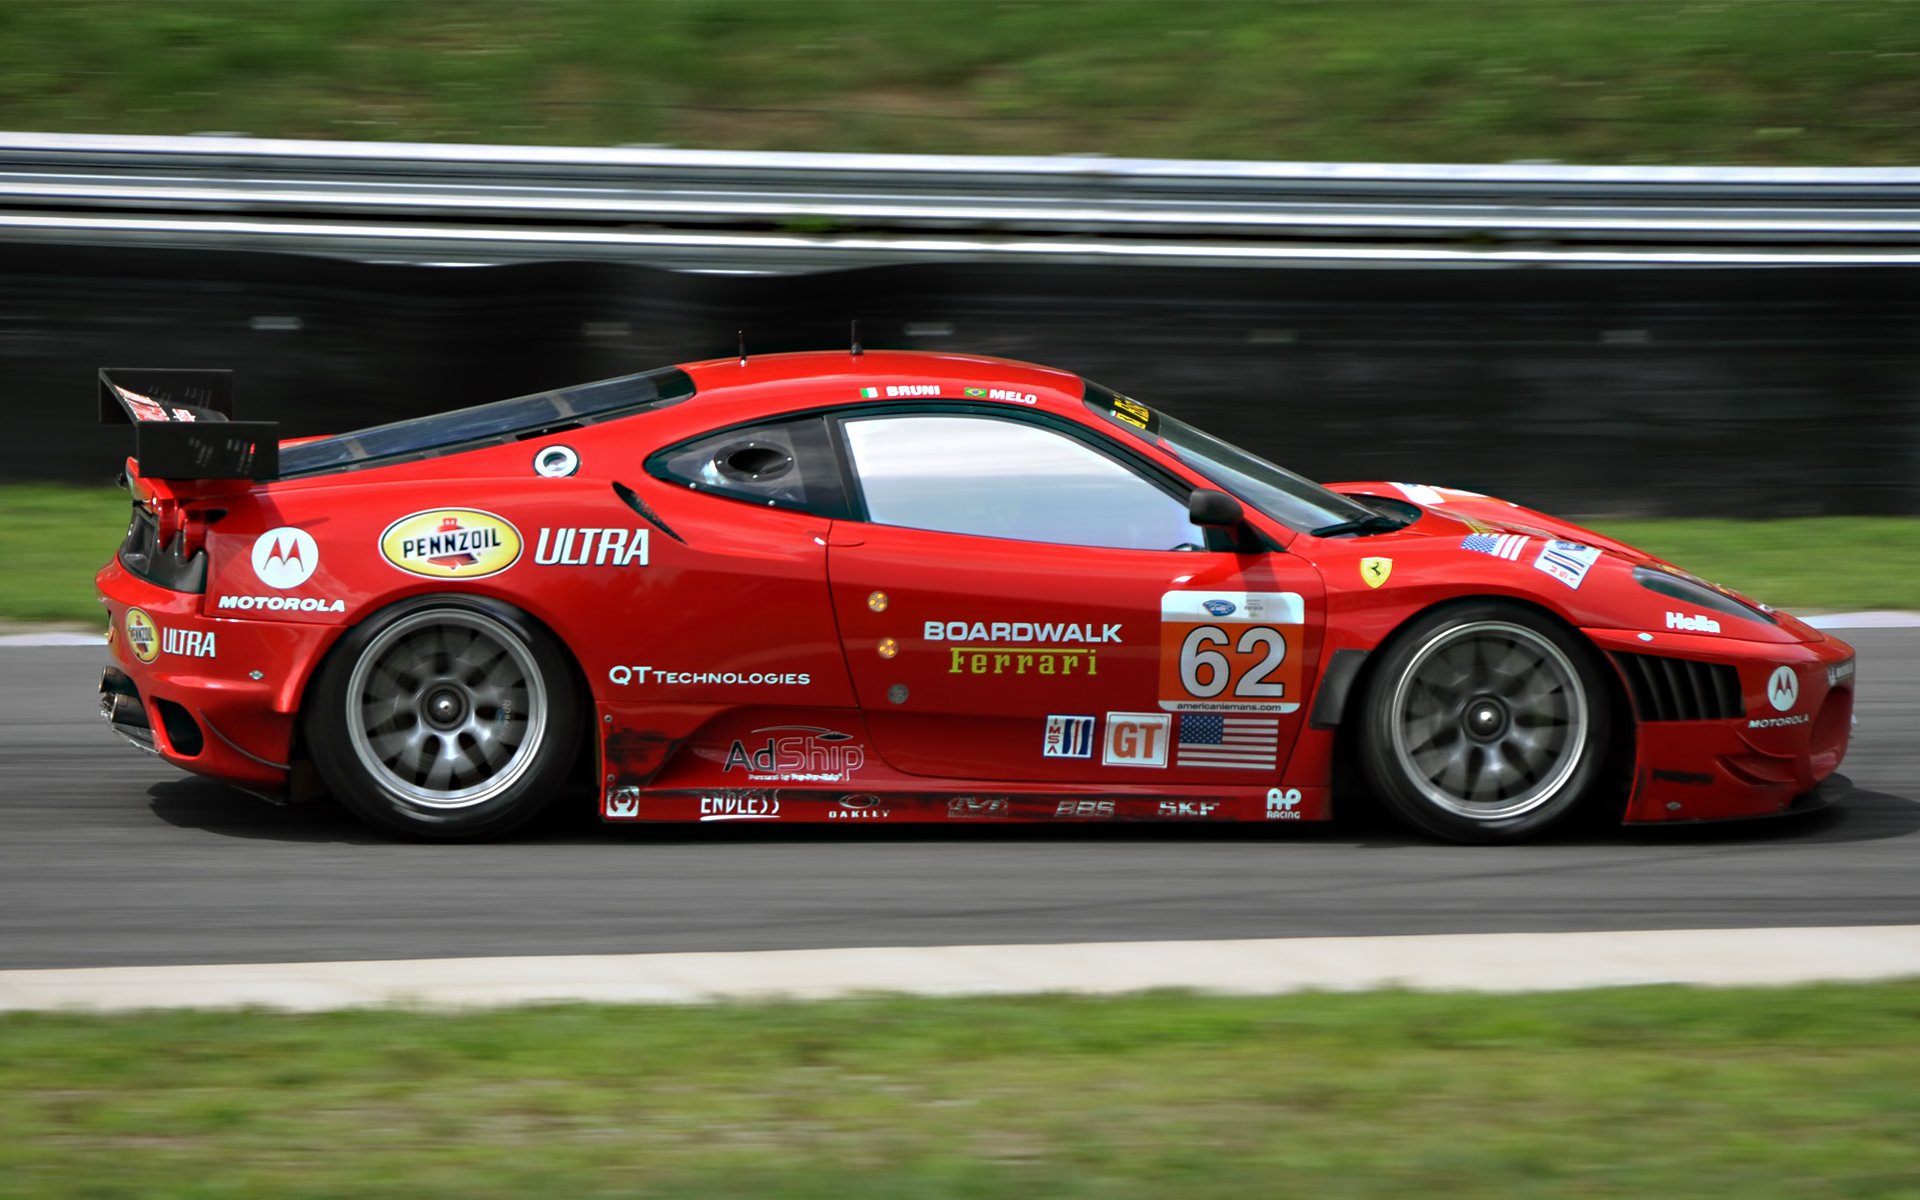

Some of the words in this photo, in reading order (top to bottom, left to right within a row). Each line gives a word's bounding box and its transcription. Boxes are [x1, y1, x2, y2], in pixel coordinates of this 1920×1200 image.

[886, 385, 941, 397] BRUNI
[989, 389, 1037, 405] MELO
[403, 528, 502, 558] PENNZOIL
[534, 527, 650, 566] ULTRA
[218, 595, 345, 613] MOTOROLA
[924, 621, 1122, 643] BOARDWALK
[1665, 611, 1721, 634] Hella
[162, 626, 216, 658] ULTRA
[948, 647, 1097, 675] Ferrari
[1178, 624, 1288, 699] 62
[1176, 701, 1282, 712] americanlemans.com
[1748, 714, 1809, 729] MOTOROLA
[1113, 722, 1163, 759] GT
[723, 736, 865, 781] AdShip
[828, 809, 890, 818] OAKLEY
[1158, 799, 1220, 816] SKF
[1266, 809, 1301, 820] RACING
